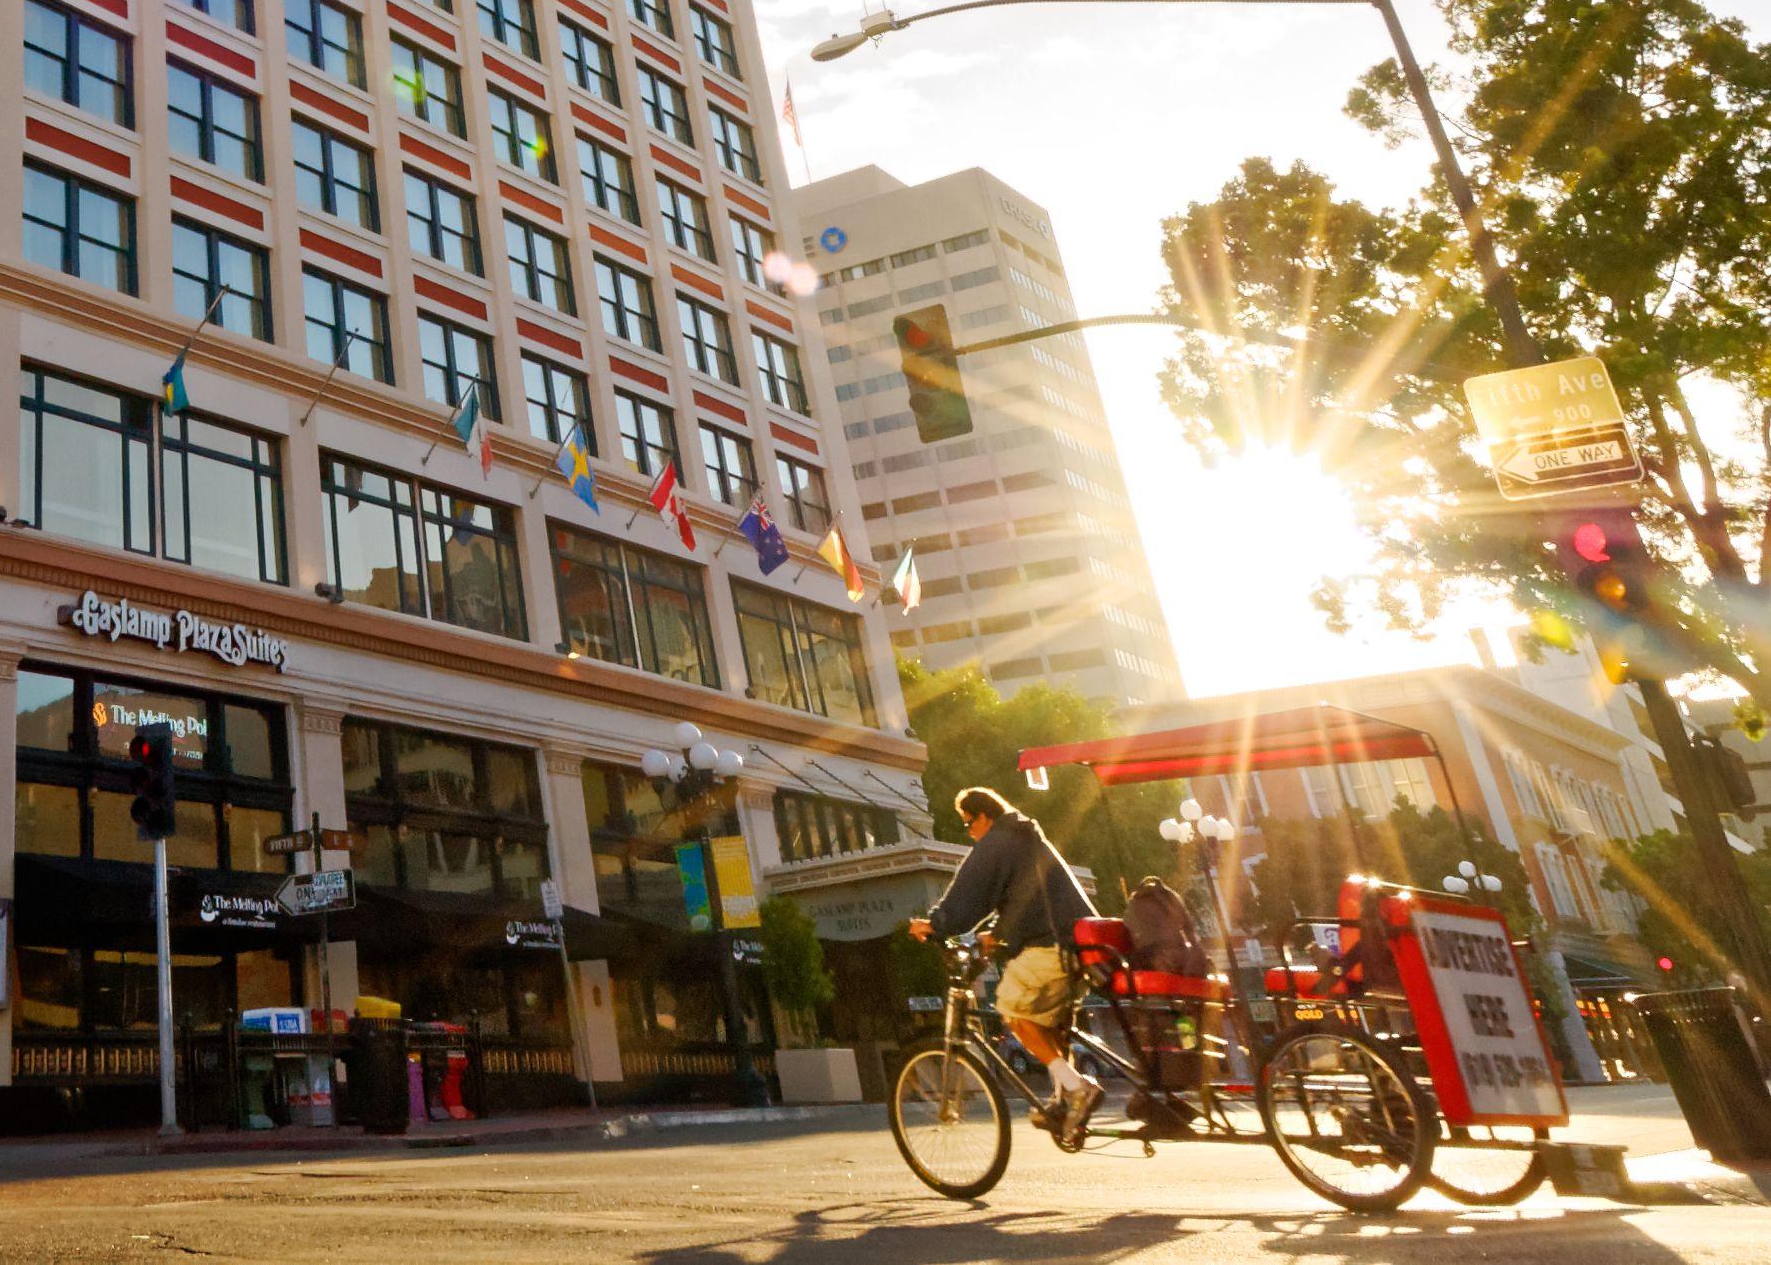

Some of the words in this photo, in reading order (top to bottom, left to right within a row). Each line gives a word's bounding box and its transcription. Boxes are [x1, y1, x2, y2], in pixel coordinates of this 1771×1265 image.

[1474, 382, 1541, 411] ifth
[1558, 372, 1605, 396] Ave
[1553, 403, 1591, 423] 900
[1534, 450, 1572, 471] ONE
[1579, 443, 1615, 464] WAY
[73, 590, 172, 650] Gaslamp
[176, 609, 233, 662] Plaza
[230, 623, 291, 674] Suites
[111, 704, 137, 726] The
[187, 715, 208, 737] Pot
[213, 895, 231, 909] The
[232, 896, 263, 915] Melting
[264, 899, 279, 913] Pot
[859, 898, 894, 913] PLAZA
[1423, 926, 1515, 978] ADVERTISE
[1463, 993, 1515, 1039] HERE
